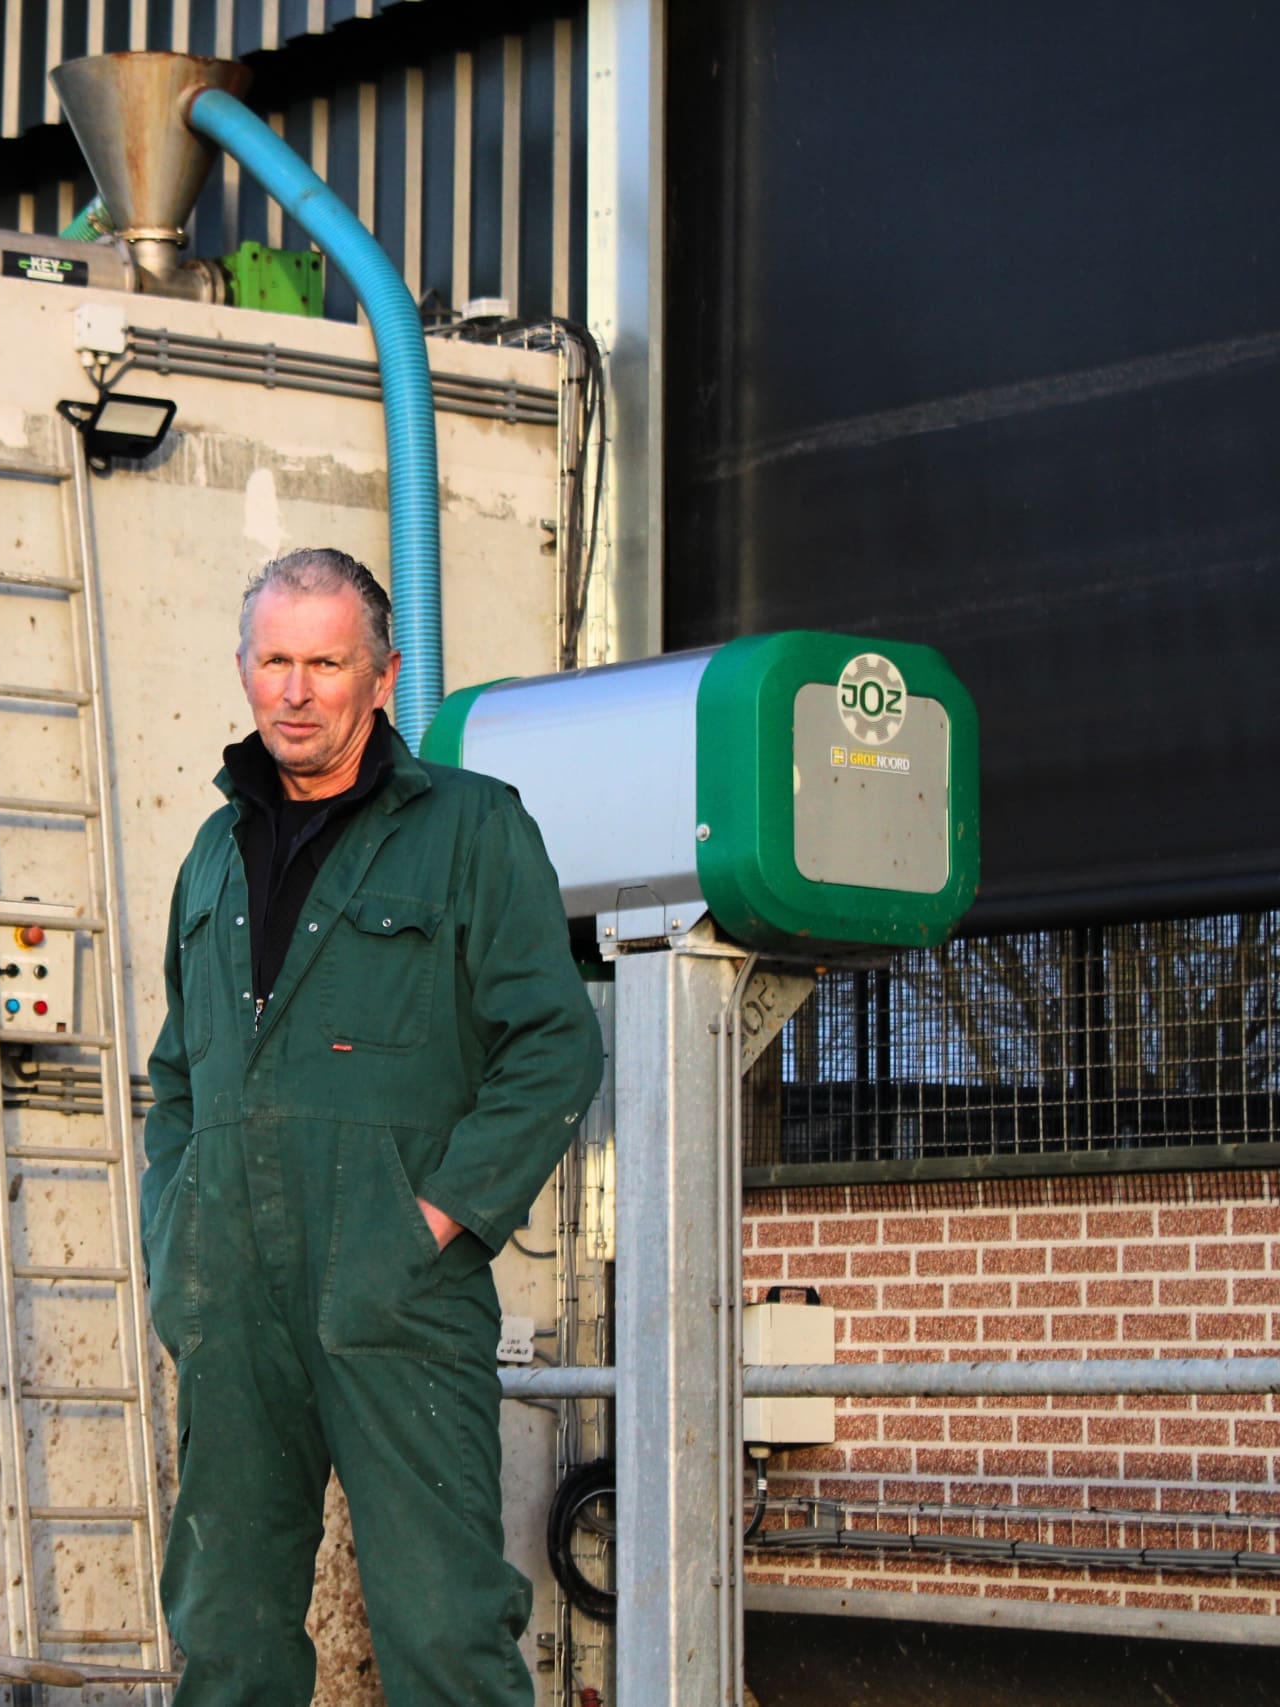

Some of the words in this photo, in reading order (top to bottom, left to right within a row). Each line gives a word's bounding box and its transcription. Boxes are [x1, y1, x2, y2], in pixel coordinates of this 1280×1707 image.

[30, 255, 60, 273] KEY
[841, 681, 903, 717] JOZ
[850, 752, 910, 771] GROENOORD
